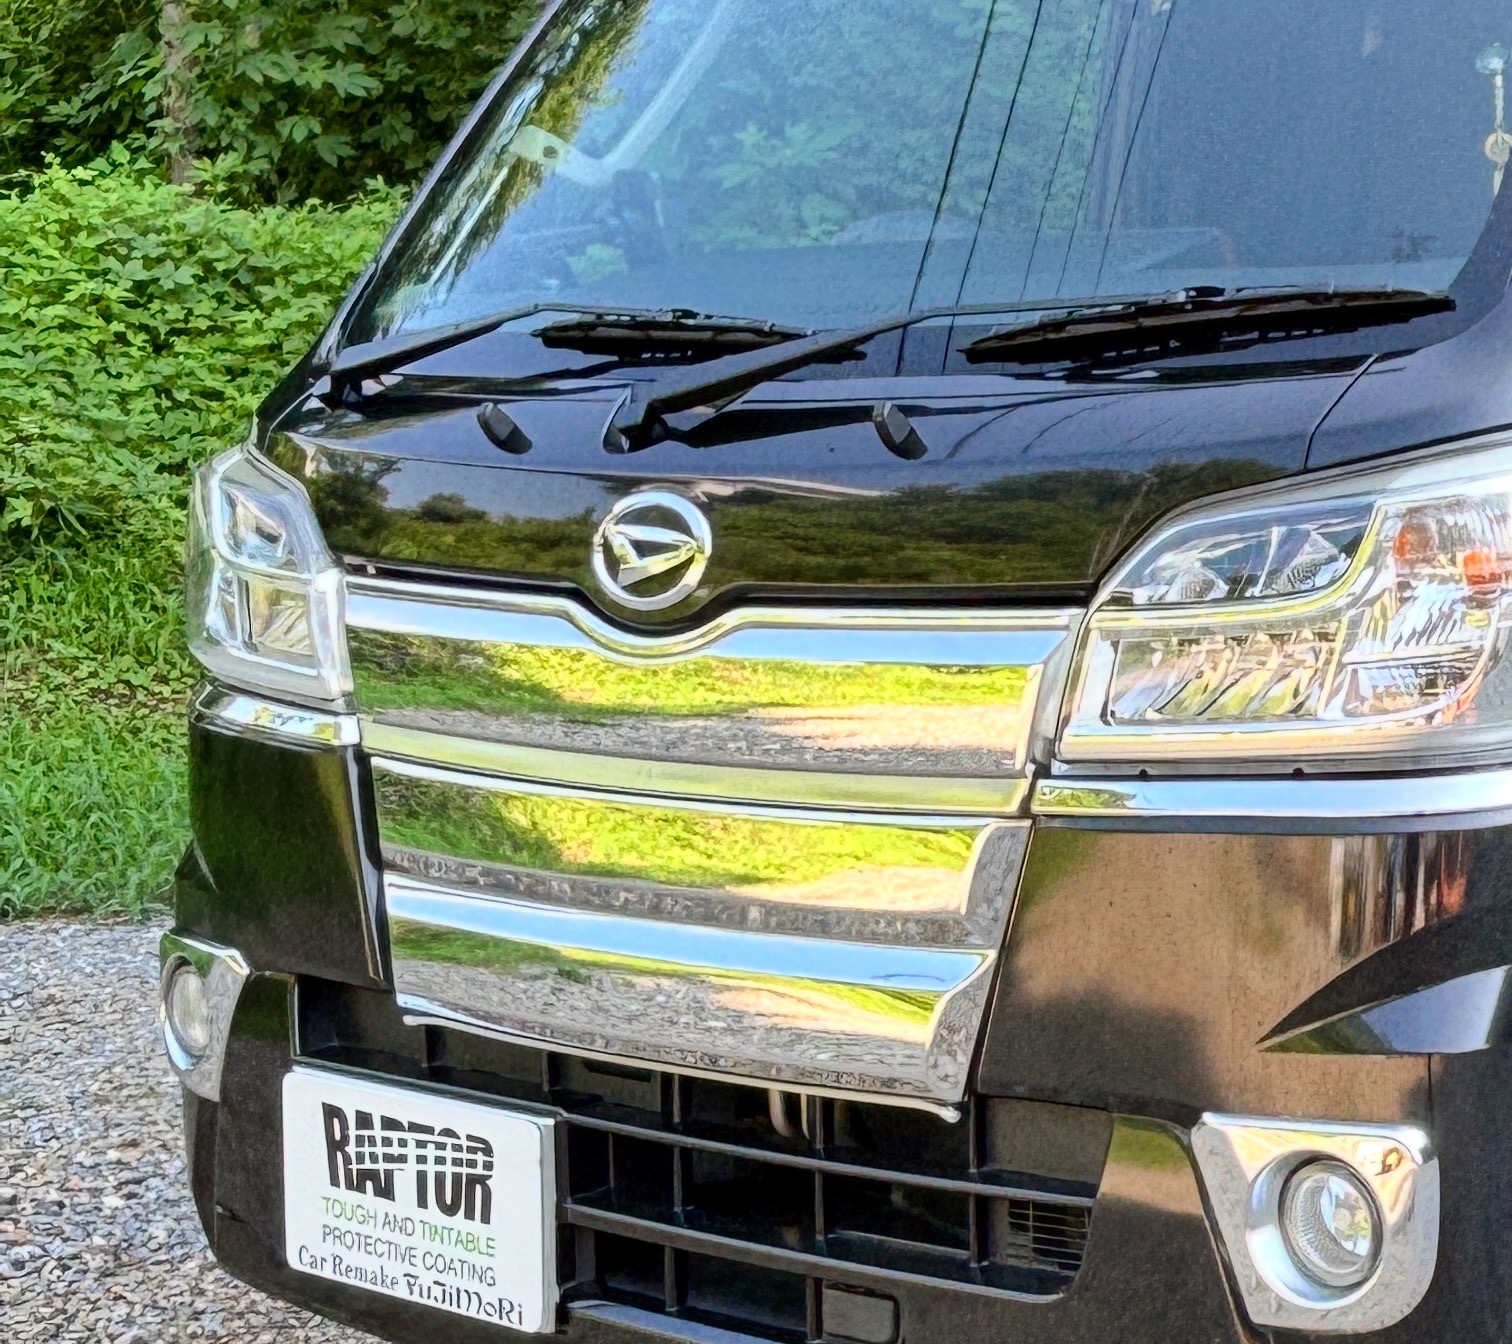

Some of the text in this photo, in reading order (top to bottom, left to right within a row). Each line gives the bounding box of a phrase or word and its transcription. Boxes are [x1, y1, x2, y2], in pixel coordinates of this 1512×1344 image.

[321, 1102, 494, 1224] RAPTOR
[321, 1196, 495, 1257] TOUGH AND TINTABLE
[322, 1225, 495, 1287] PROTECTIVE COATING
[299, 1245, 327, 1271] Car
[333, 1253, 399, 1291] Remake
